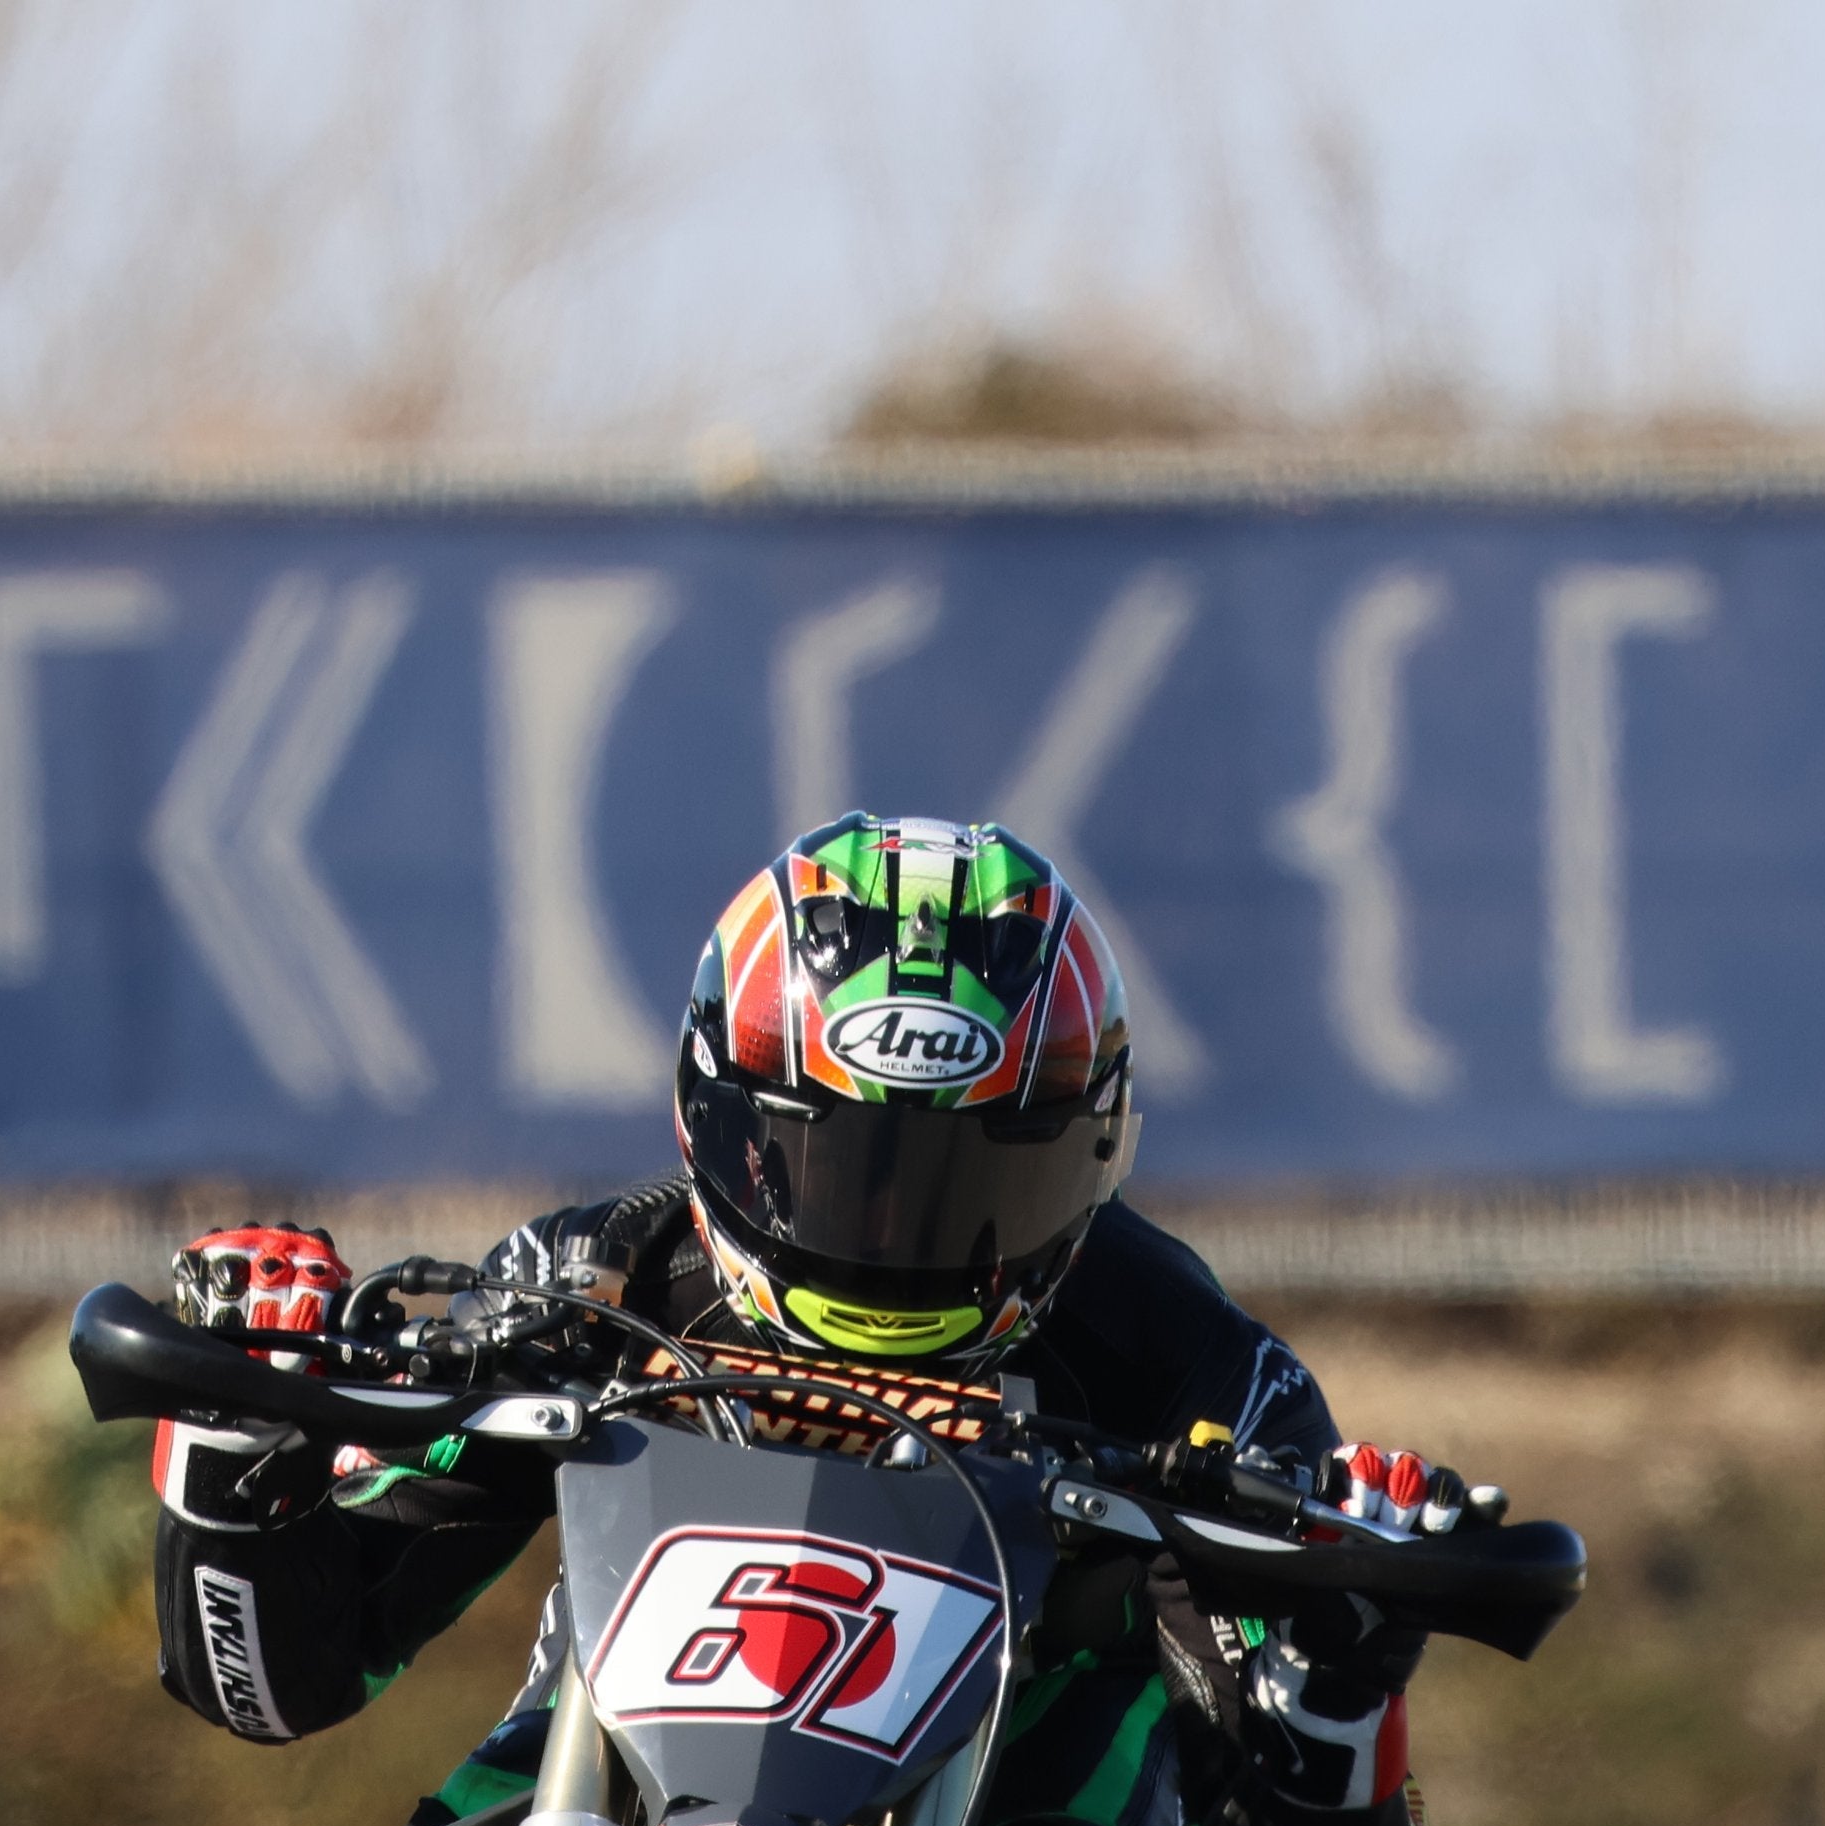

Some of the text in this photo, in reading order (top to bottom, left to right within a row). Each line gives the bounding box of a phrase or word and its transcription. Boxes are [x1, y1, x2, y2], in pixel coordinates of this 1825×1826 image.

[835, 1010, 982, 1062] Arai
[879, 1060, 944, 1075] HELMET
[588, 1525, 1006, 1767] 61
